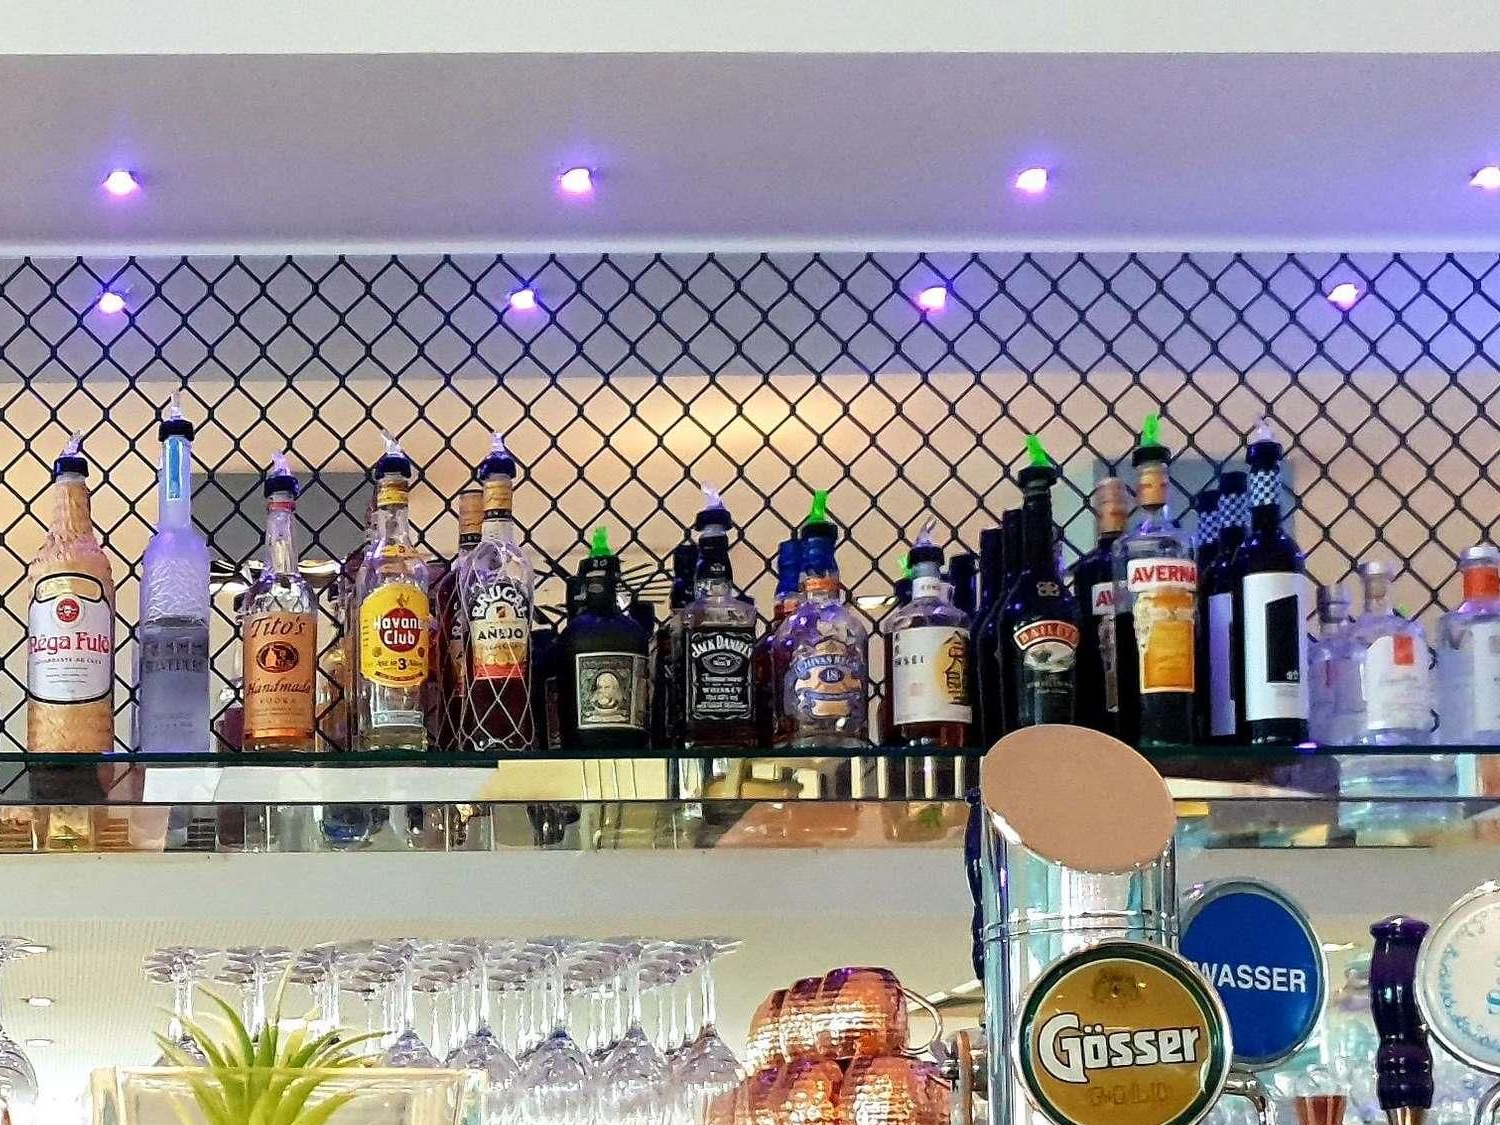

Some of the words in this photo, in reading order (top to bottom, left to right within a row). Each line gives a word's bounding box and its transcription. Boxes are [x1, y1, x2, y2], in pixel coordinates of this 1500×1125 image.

[251, 616, 306, 638] Tito's
[383, 629, 416, 645] Club
[397, 657, 408, 671] 3
[1038, 1012, 1199, 1084] Gösser
